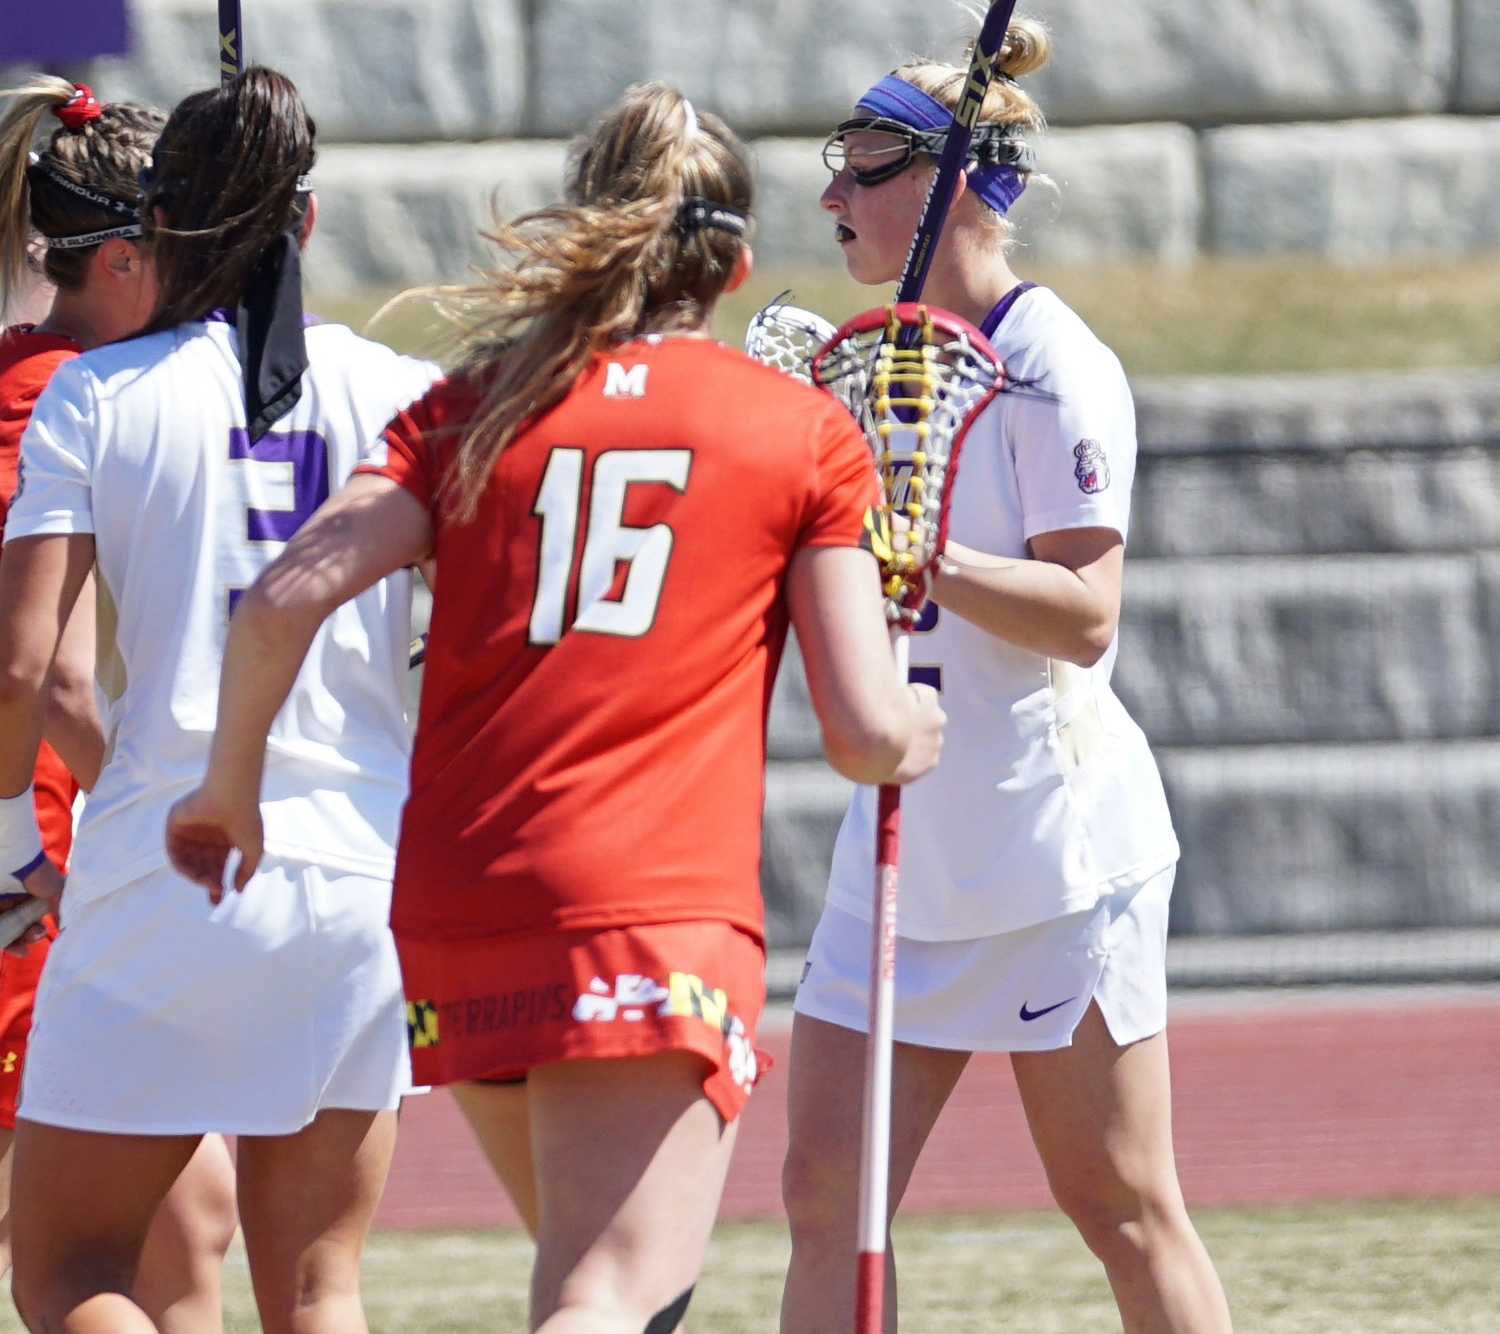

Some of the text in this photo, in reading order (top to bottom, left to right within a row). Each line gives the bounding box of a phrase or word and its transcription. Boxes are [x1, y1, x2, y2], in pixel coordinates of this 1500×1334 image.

[954, 45, 999, 134] STX
[602, 362, 649, 398] M
[528, 447, 692, 645] 16
